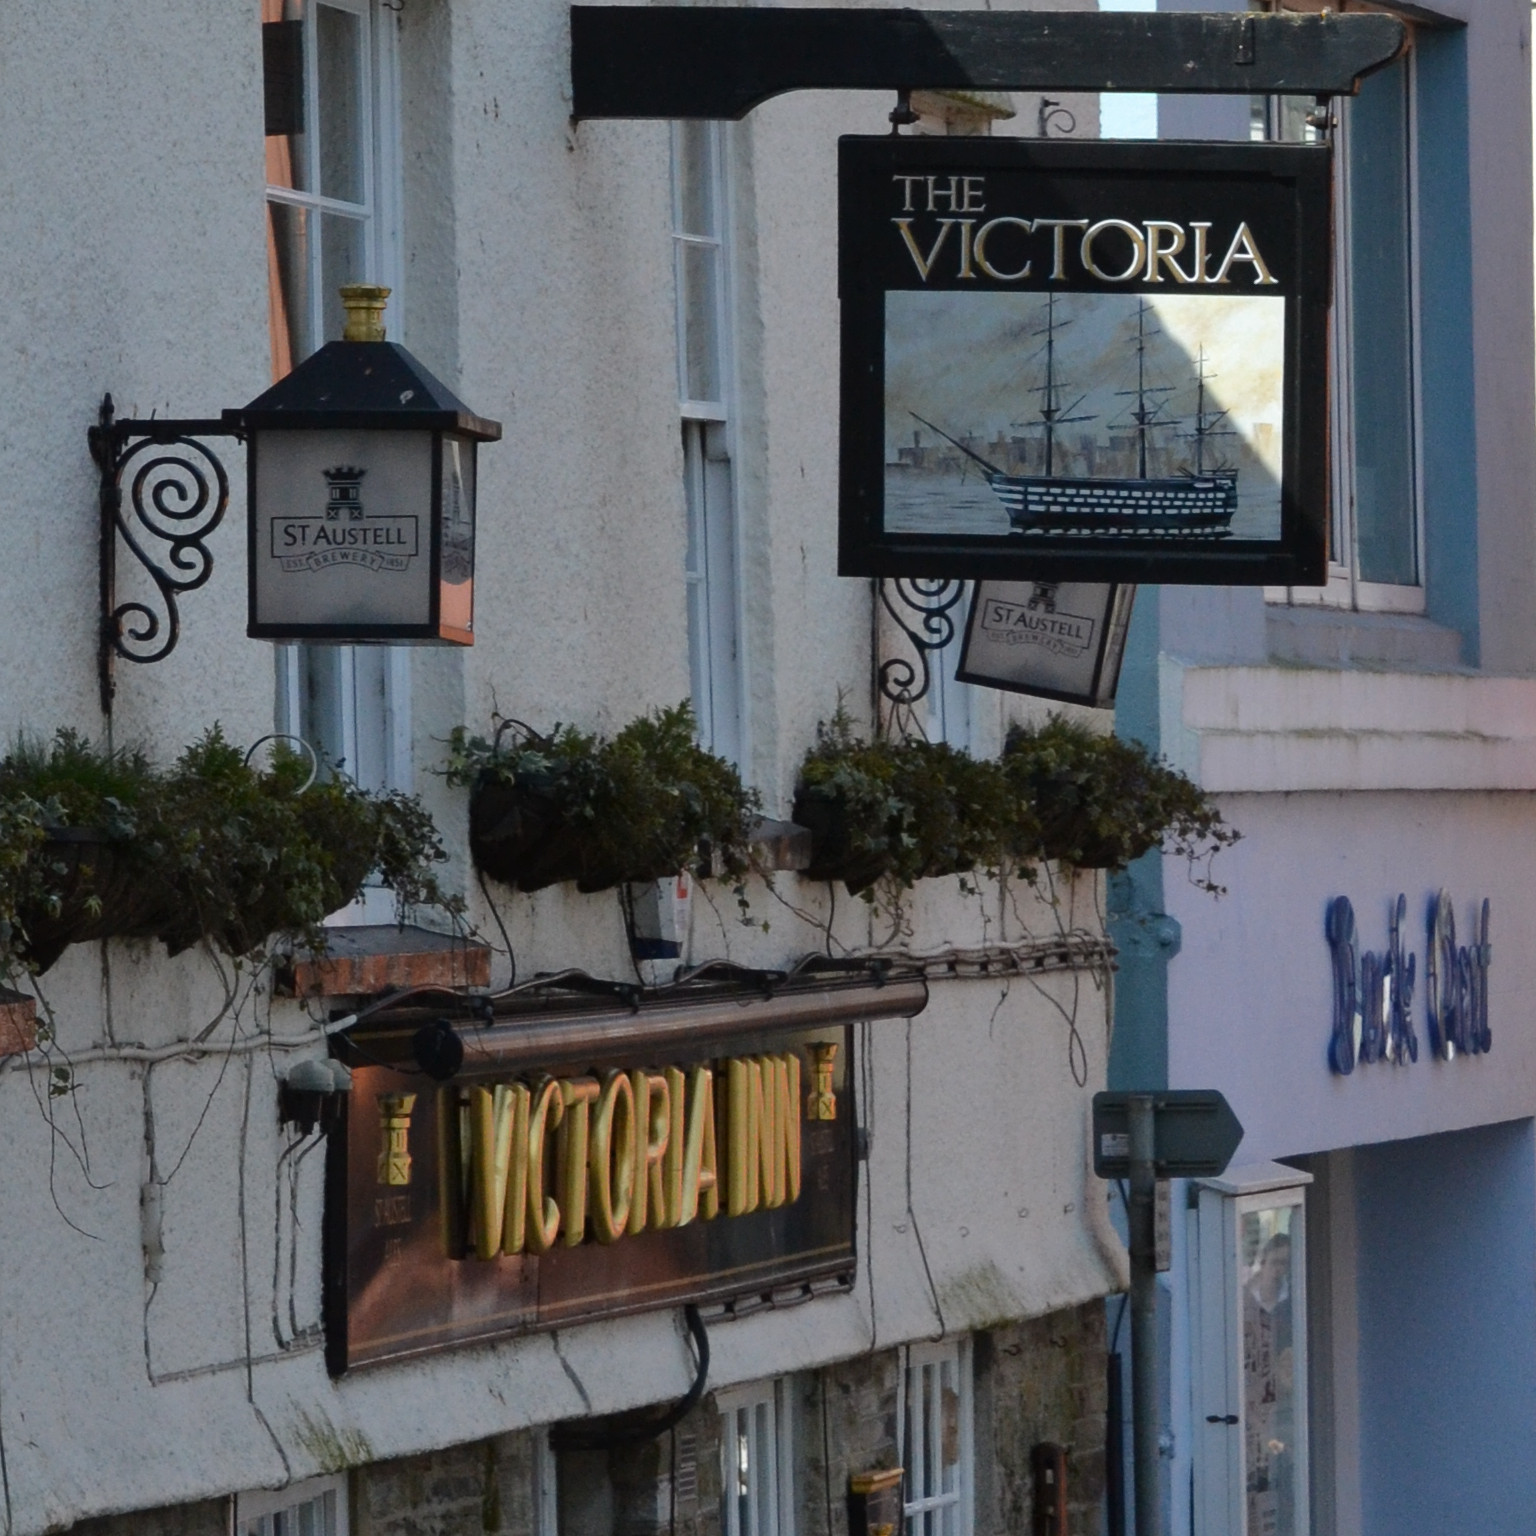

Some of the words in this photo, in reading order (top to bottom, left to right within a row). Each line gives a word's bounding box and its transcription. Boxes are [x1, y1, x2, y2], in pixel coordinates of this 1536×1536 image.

[892, 175, 987, 214] THE
[891, 216, 1279, 284] VICTORIA
[283, 524, 310, 547] ST
[313, 524, 407, 546] AUSTELL
[314, 551, 377, 566] BREWERY
[992, 606, 1015, 624] ST
[1013, 611, 1083, 640] AUSTELL
[470, 1066, 720, 1261] VICTORIA
[727, 1052, 802, 1218] INN
